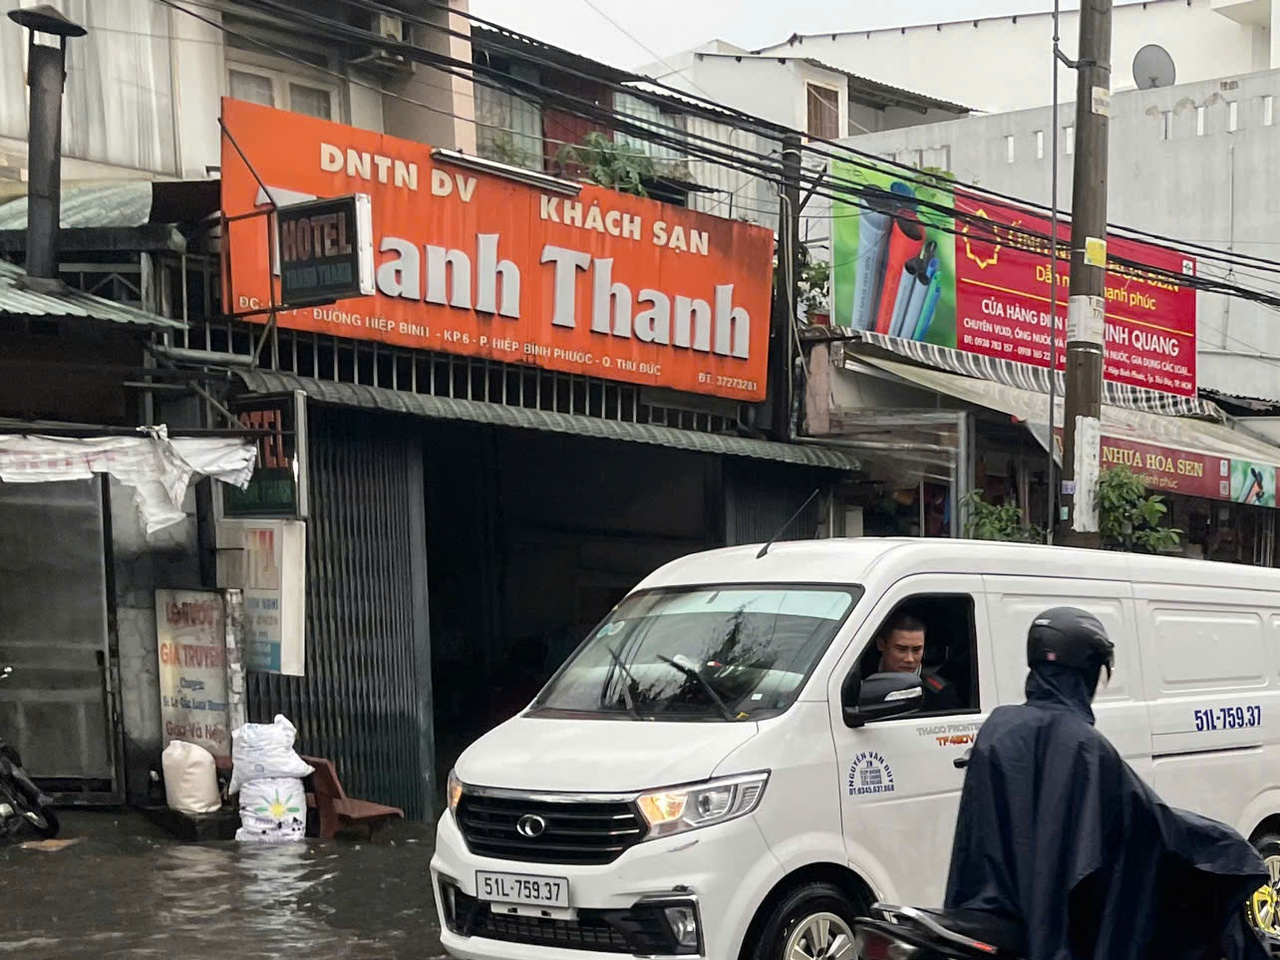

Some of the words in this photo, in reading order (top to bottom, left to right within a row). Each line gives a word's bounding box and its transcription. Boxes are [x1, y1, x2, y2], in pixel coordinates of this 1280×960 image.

[320, 143, 418, 191] DNTN
[431, 167, 478, 204] DV
[282, 212, 352, 261] HOTEL
[540, 195, 642, 241] KHÁCH
[653, 220, 710, 256] SẠN
[540, 245, 750, 359] Thanh
[1130, 291, 1156, 310] phúc
[982, 296, 1004, 318] CỬA
[1006, 303, 1037, 324] HÀNG
[1040, 311, 1063, 330] ĐIN
[1104, 323, 1129, 345] INH
[1131, 329, 1179, 357] QUANG
[493, 337, 518, 352] HIỆP
[716, 376, 757, 391] 37273281
[1102, 446, 1143, 467] NHỰA
[1146, 454, 1175, 473] HOA
[1177, 459, 1203, 477] SEN
[160, 643, 181, 665] GIA
[1194, 705, 1262, 731] 51L-759.37
[484, 876, 561, 902] 51L-759.37
